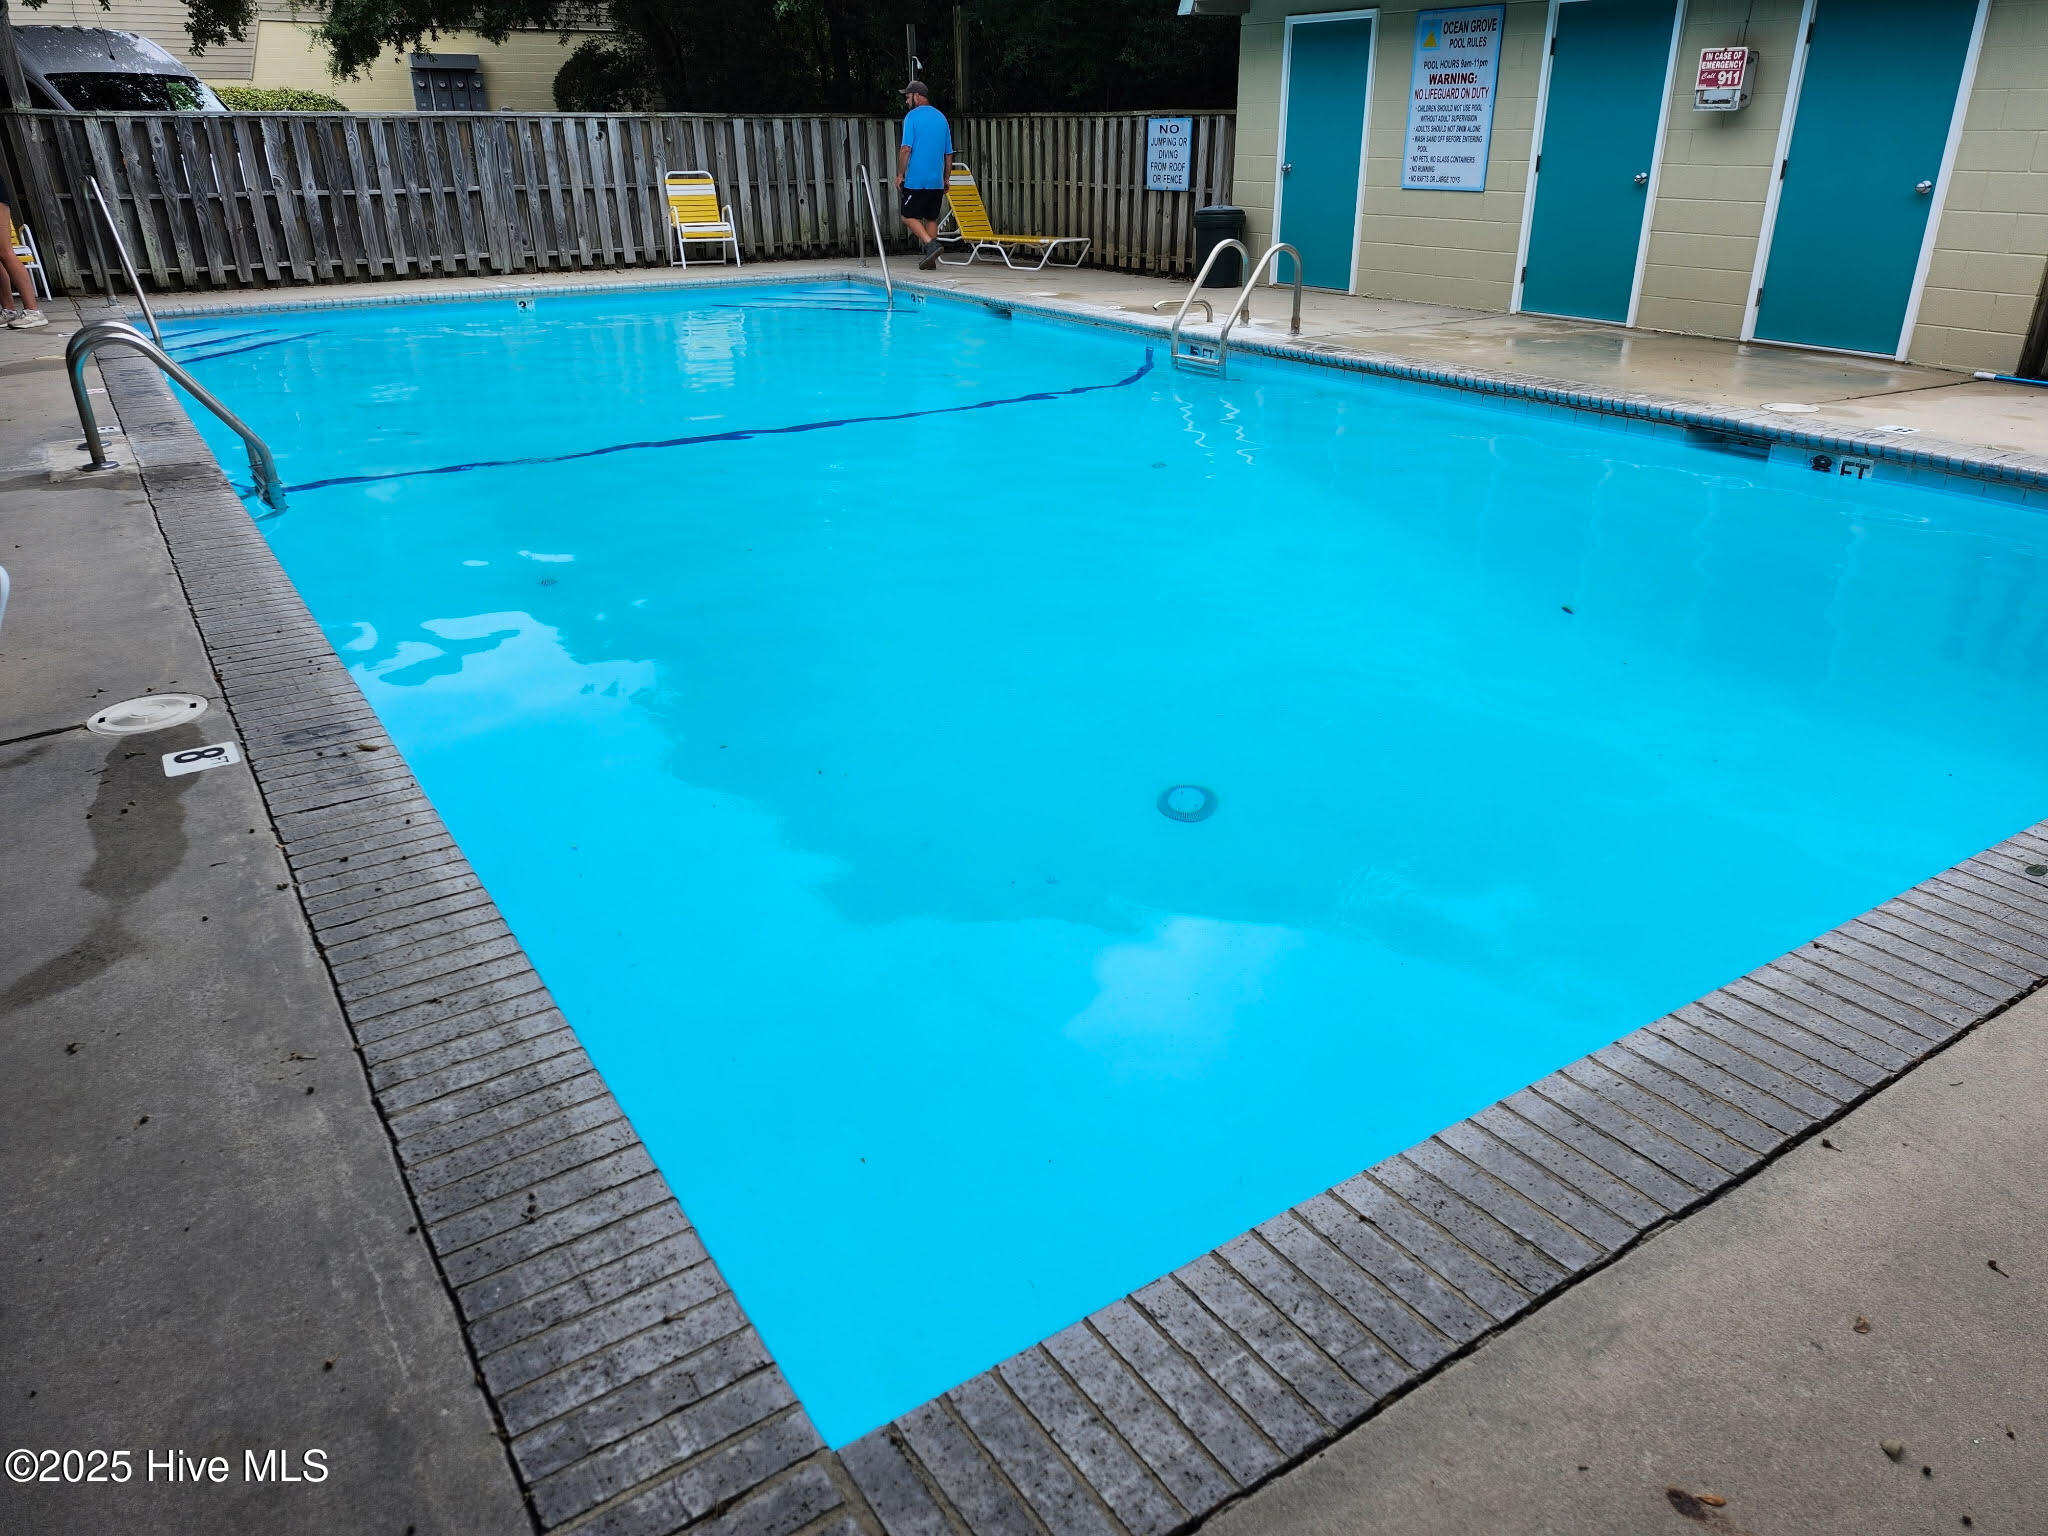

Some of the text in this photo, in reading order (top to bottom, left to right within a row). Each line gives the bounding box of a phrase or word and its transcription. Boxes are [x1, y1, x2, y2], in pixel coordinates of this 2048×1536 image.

[1443, 18, 1498, 34] OCEAN GROVE
[1449, 36, 1487, 48] POOL RULES
[1715, 52, 1732, 60] CASE
[1734, 51, 1742, 59] OF
[1423, 59, 1488, 70] POOL HOURS 9am-11pm
[1702, 60, 1743, 69] EMERGENCY
[1429, 72, 1478, 85] WARNING:
[1701, 71, 1740, 85] Call 911
[1415, 87, 1489, 100] NO LIFEGUARD ON DUTY
[1417, 104, 1483, 112] CHILDREN SHOULD NOT USE POOL
[1451, 114, 1477, 122] SUPERVISION
[1159, 124, 1180, 134] NO
[1415, 125, 1430, 133] ADULTS
[1431, 125, 1446, 133] SHOULD
[1150, 137, 1188, 147] JUMPING OR
[1414, 135, 1482, 143] WASH SAND OFF BEFORE ENTERING
[1417, 145, 1428, 153] POOL
[1158, 150, 1178, 159] DIVING
[1412, 155, 1419, 163] NO
[1430, 155, 1436, 163] NO
[1437, 155, 1450, 163] GLASS
[1450, 155, 1475, 163] CONTAINERS
[1150, 162, 1185, 172] FROM ROOF
[1418, 165, 1435, 173] RUNNING
[1152, 174, 1182, 184] OR FENCE
[1436, 175, 1450, 183] LARGE
[1202, 348, 1215, 359] FT
[1840, 461, 1871, 480] FT
[173, 746, 226, 764] 8
